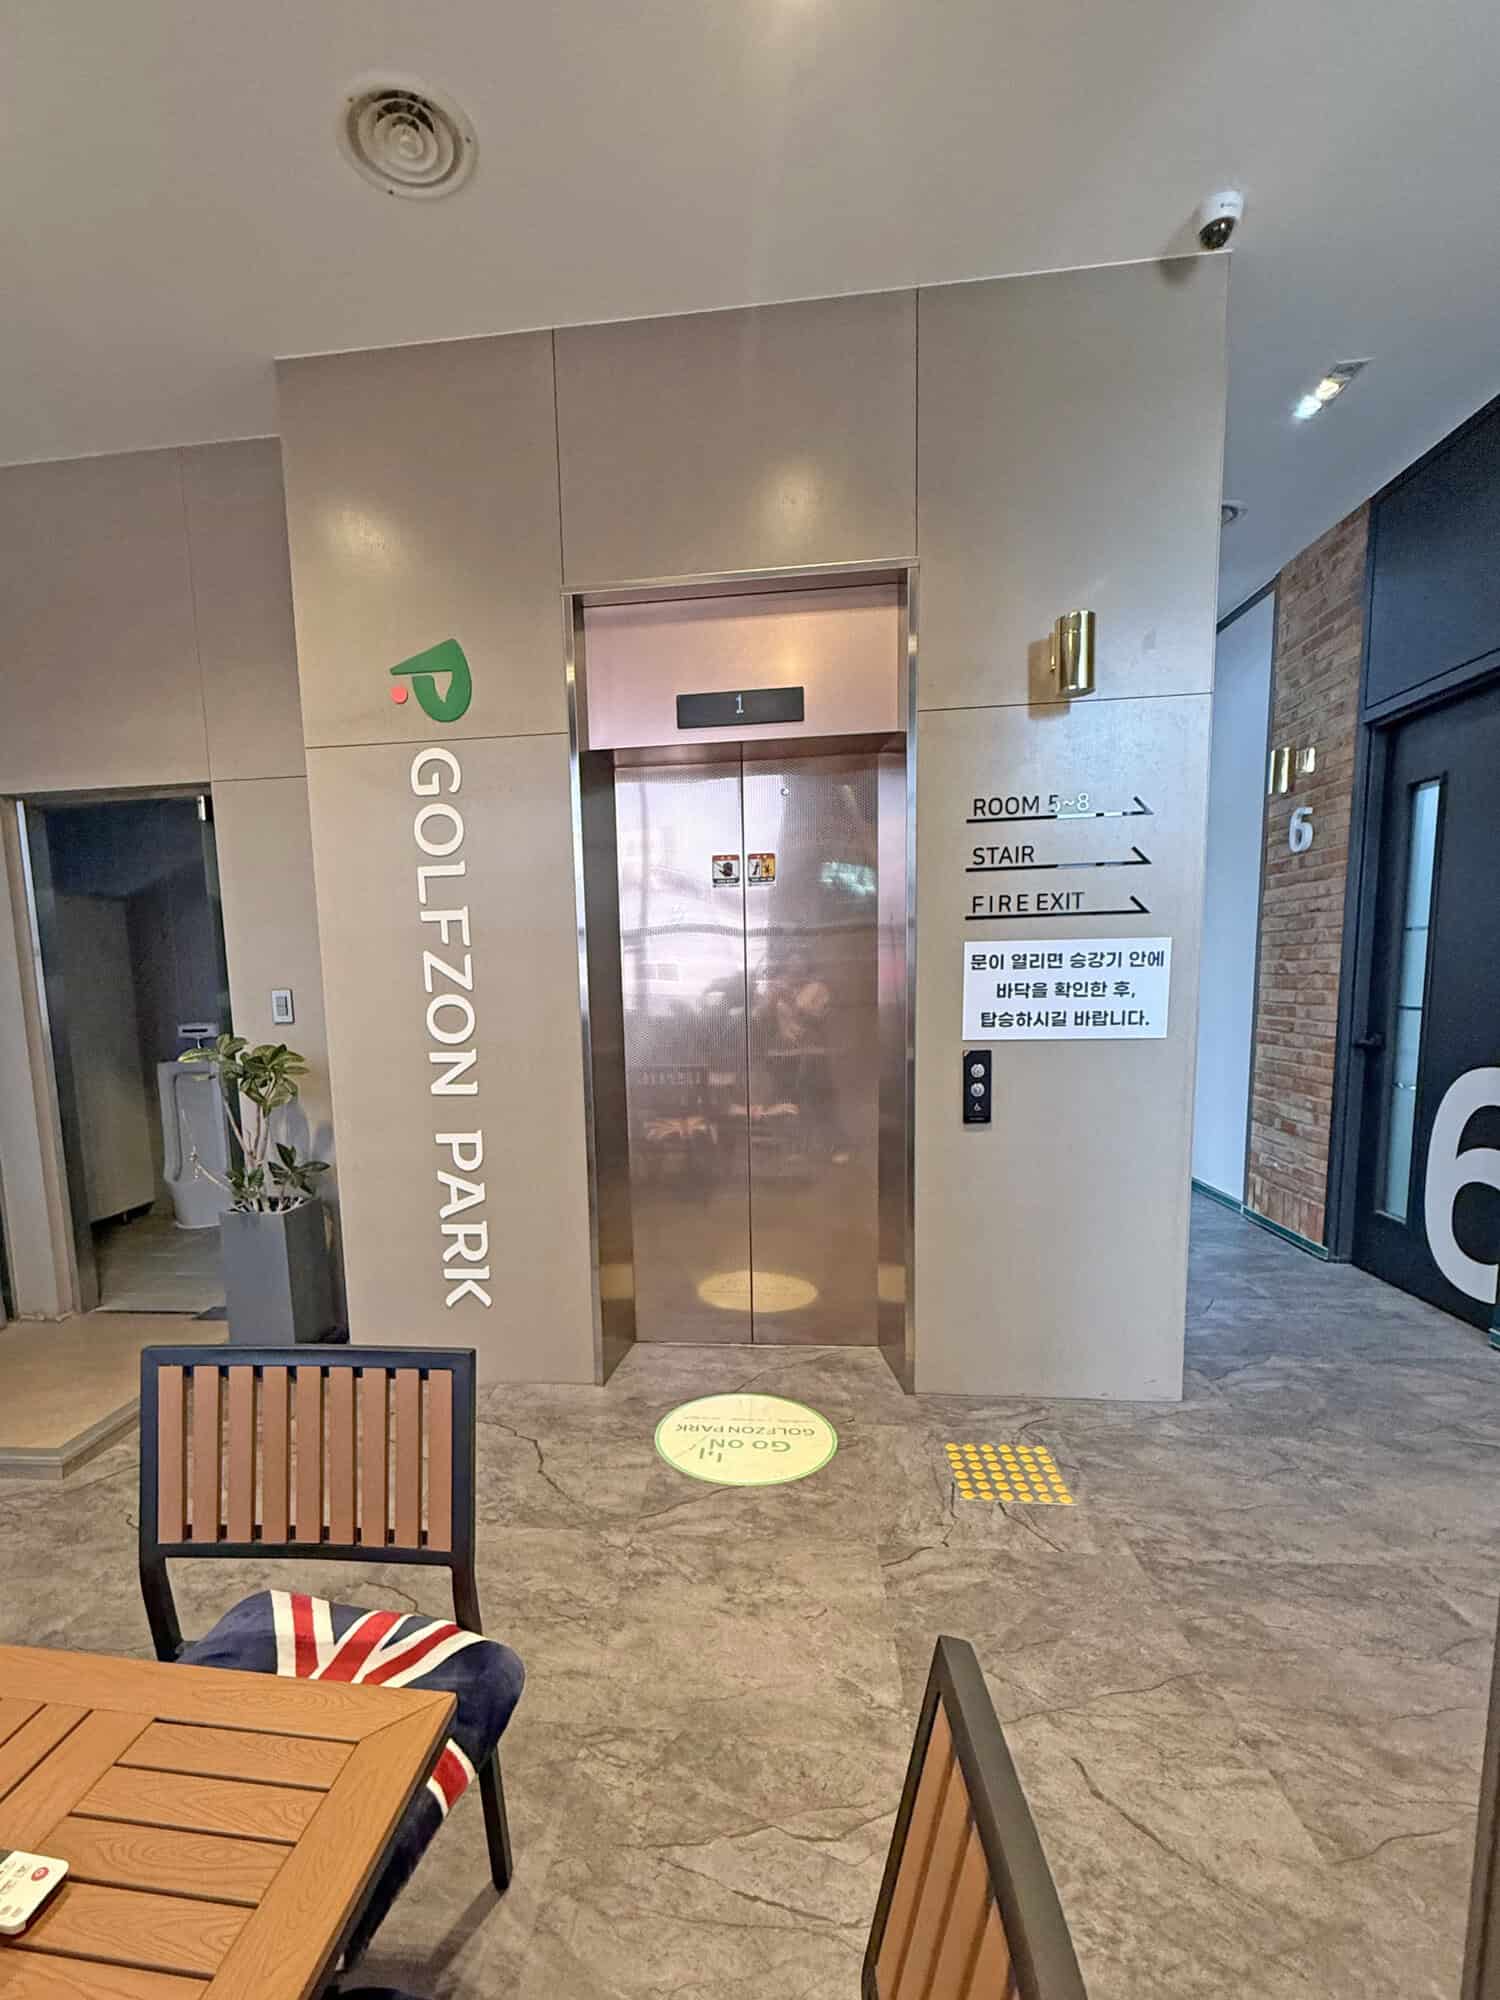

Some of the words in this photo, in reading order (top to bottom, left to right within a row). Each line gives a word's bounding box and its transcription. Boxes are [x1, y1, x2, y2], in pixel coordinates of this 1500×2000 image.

[736, 693, 744, 714] 1
[973, 795, 1040, 817] ROOM
[1288, 806, 1314, 853] 6
[972, 845, 1035, 865] STAIR
[972, 893, 1029, 913] FIRE
[1036, 891, 1085, 911] EXIT
[409, 746, 479, 1096] GOLFZON
[970, 953, 1005, 970] 문이
[1011, 952, 1063, 969] 열리면
[1069, 951, 1122, 968] 승강기
[1129, 950, 1165, 968] 안에
[996, 981, 1048, 999] 바닥을
[1054, 981, 1107, 998] 확인한
[1113, 981, 1136, 999] 후,
[980, 1010, 1067, 1028] 탑승하시길
[1073, 1009, 1150, 1027] 바랍니다.
[434, 1129, 492, 1309] PARK
